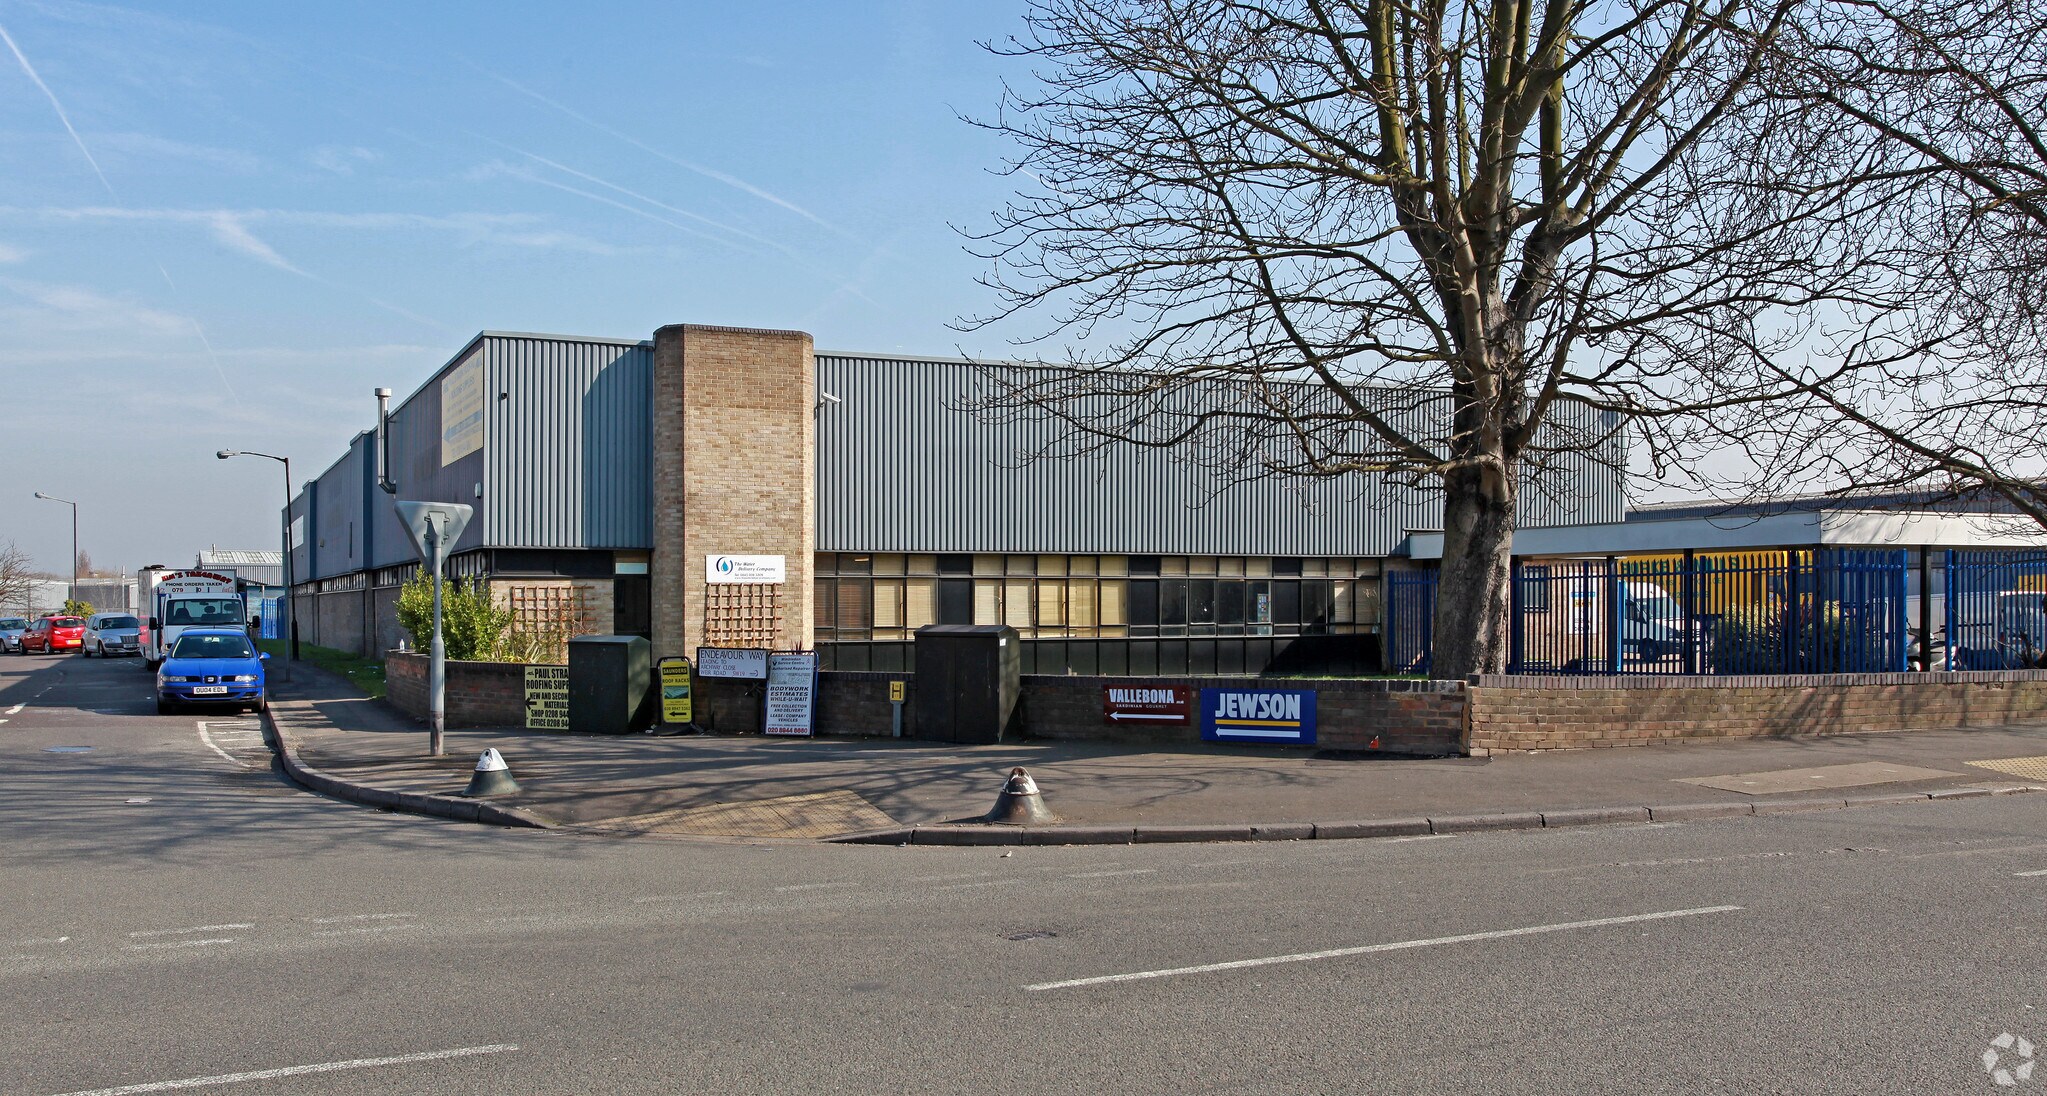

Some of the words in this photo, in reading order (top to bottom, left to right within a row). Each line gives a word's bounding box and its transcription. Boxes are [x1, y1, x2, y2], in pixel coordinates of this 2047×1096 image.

[700, 649, 744, 660] ENDEAVOUR
[748, 650, 764, 660] WAY
[534, 668, 550, 679] PAUL
[526, 679, 552, 690] ROOFING
[529, 692, 541, 700] NEW
[541, 692, 552, 700] AND
[891, 683, 902, 699] H
[1108, 688, 1175, 704] VALLEBONA
[1215, 692, 1300, 720] JEWSON
[530, 709, 544, 718] SHOP
[529, 718, 546, 727] OFFICE
